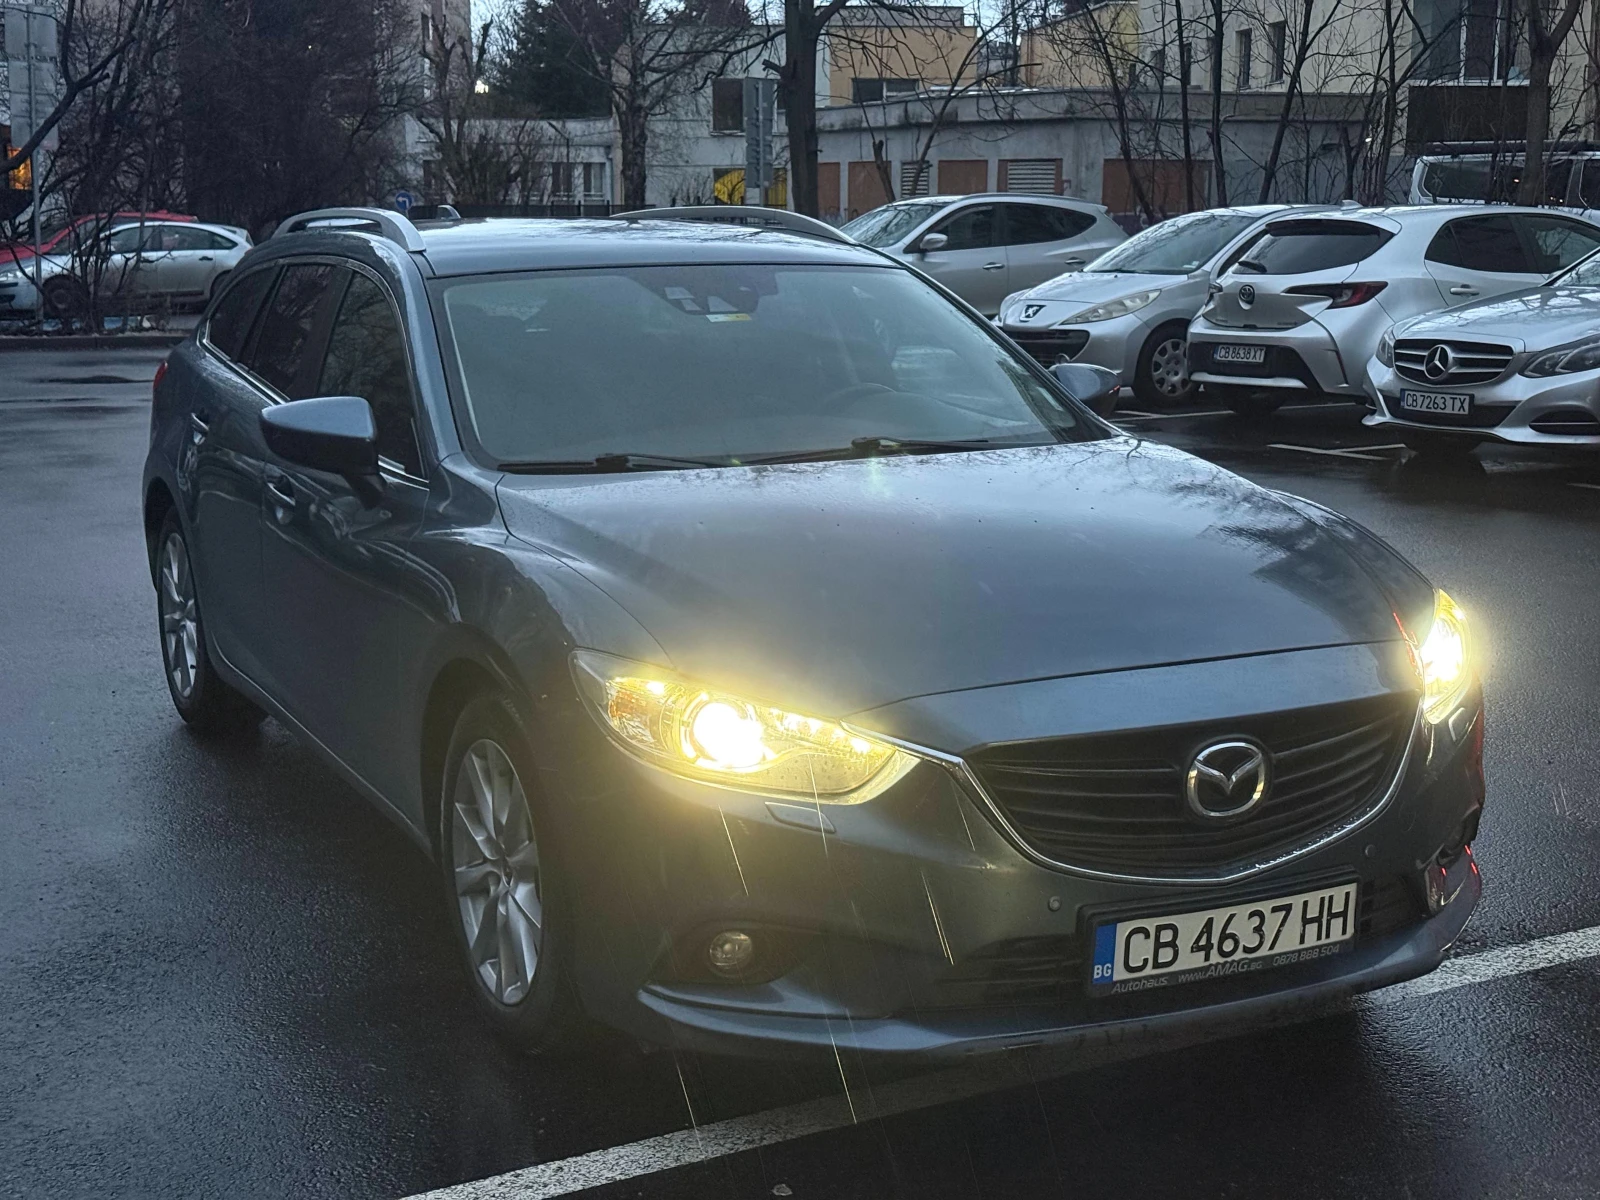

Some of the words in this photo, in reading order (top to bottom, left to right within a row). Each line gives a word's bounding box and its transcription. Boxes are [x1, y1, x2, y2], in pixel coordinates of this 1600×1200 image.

[1218, 346, 1231, 358] CB
[1231, 347, 1252, 360] 8638
[1252, 348, 1264, 361] XT
[1406, 393, 1417, 408] CB
[1419, 395, 1446, 410] 7263
[1449, 397, 1466, 412] TX
[1123, 922, 1179, 973] CB
[1189, 902, 1293, 962] 4637
[1299, 891, 1350, 945] HH
[1093, 963, 1112, 979] BG
[1111, 975, 1168, 993] Autohaus
[1272, 953, 1298, 966] 0878
[1299, 949, 1320, 962] 888
[1320, 944, 1341, 958] 504
